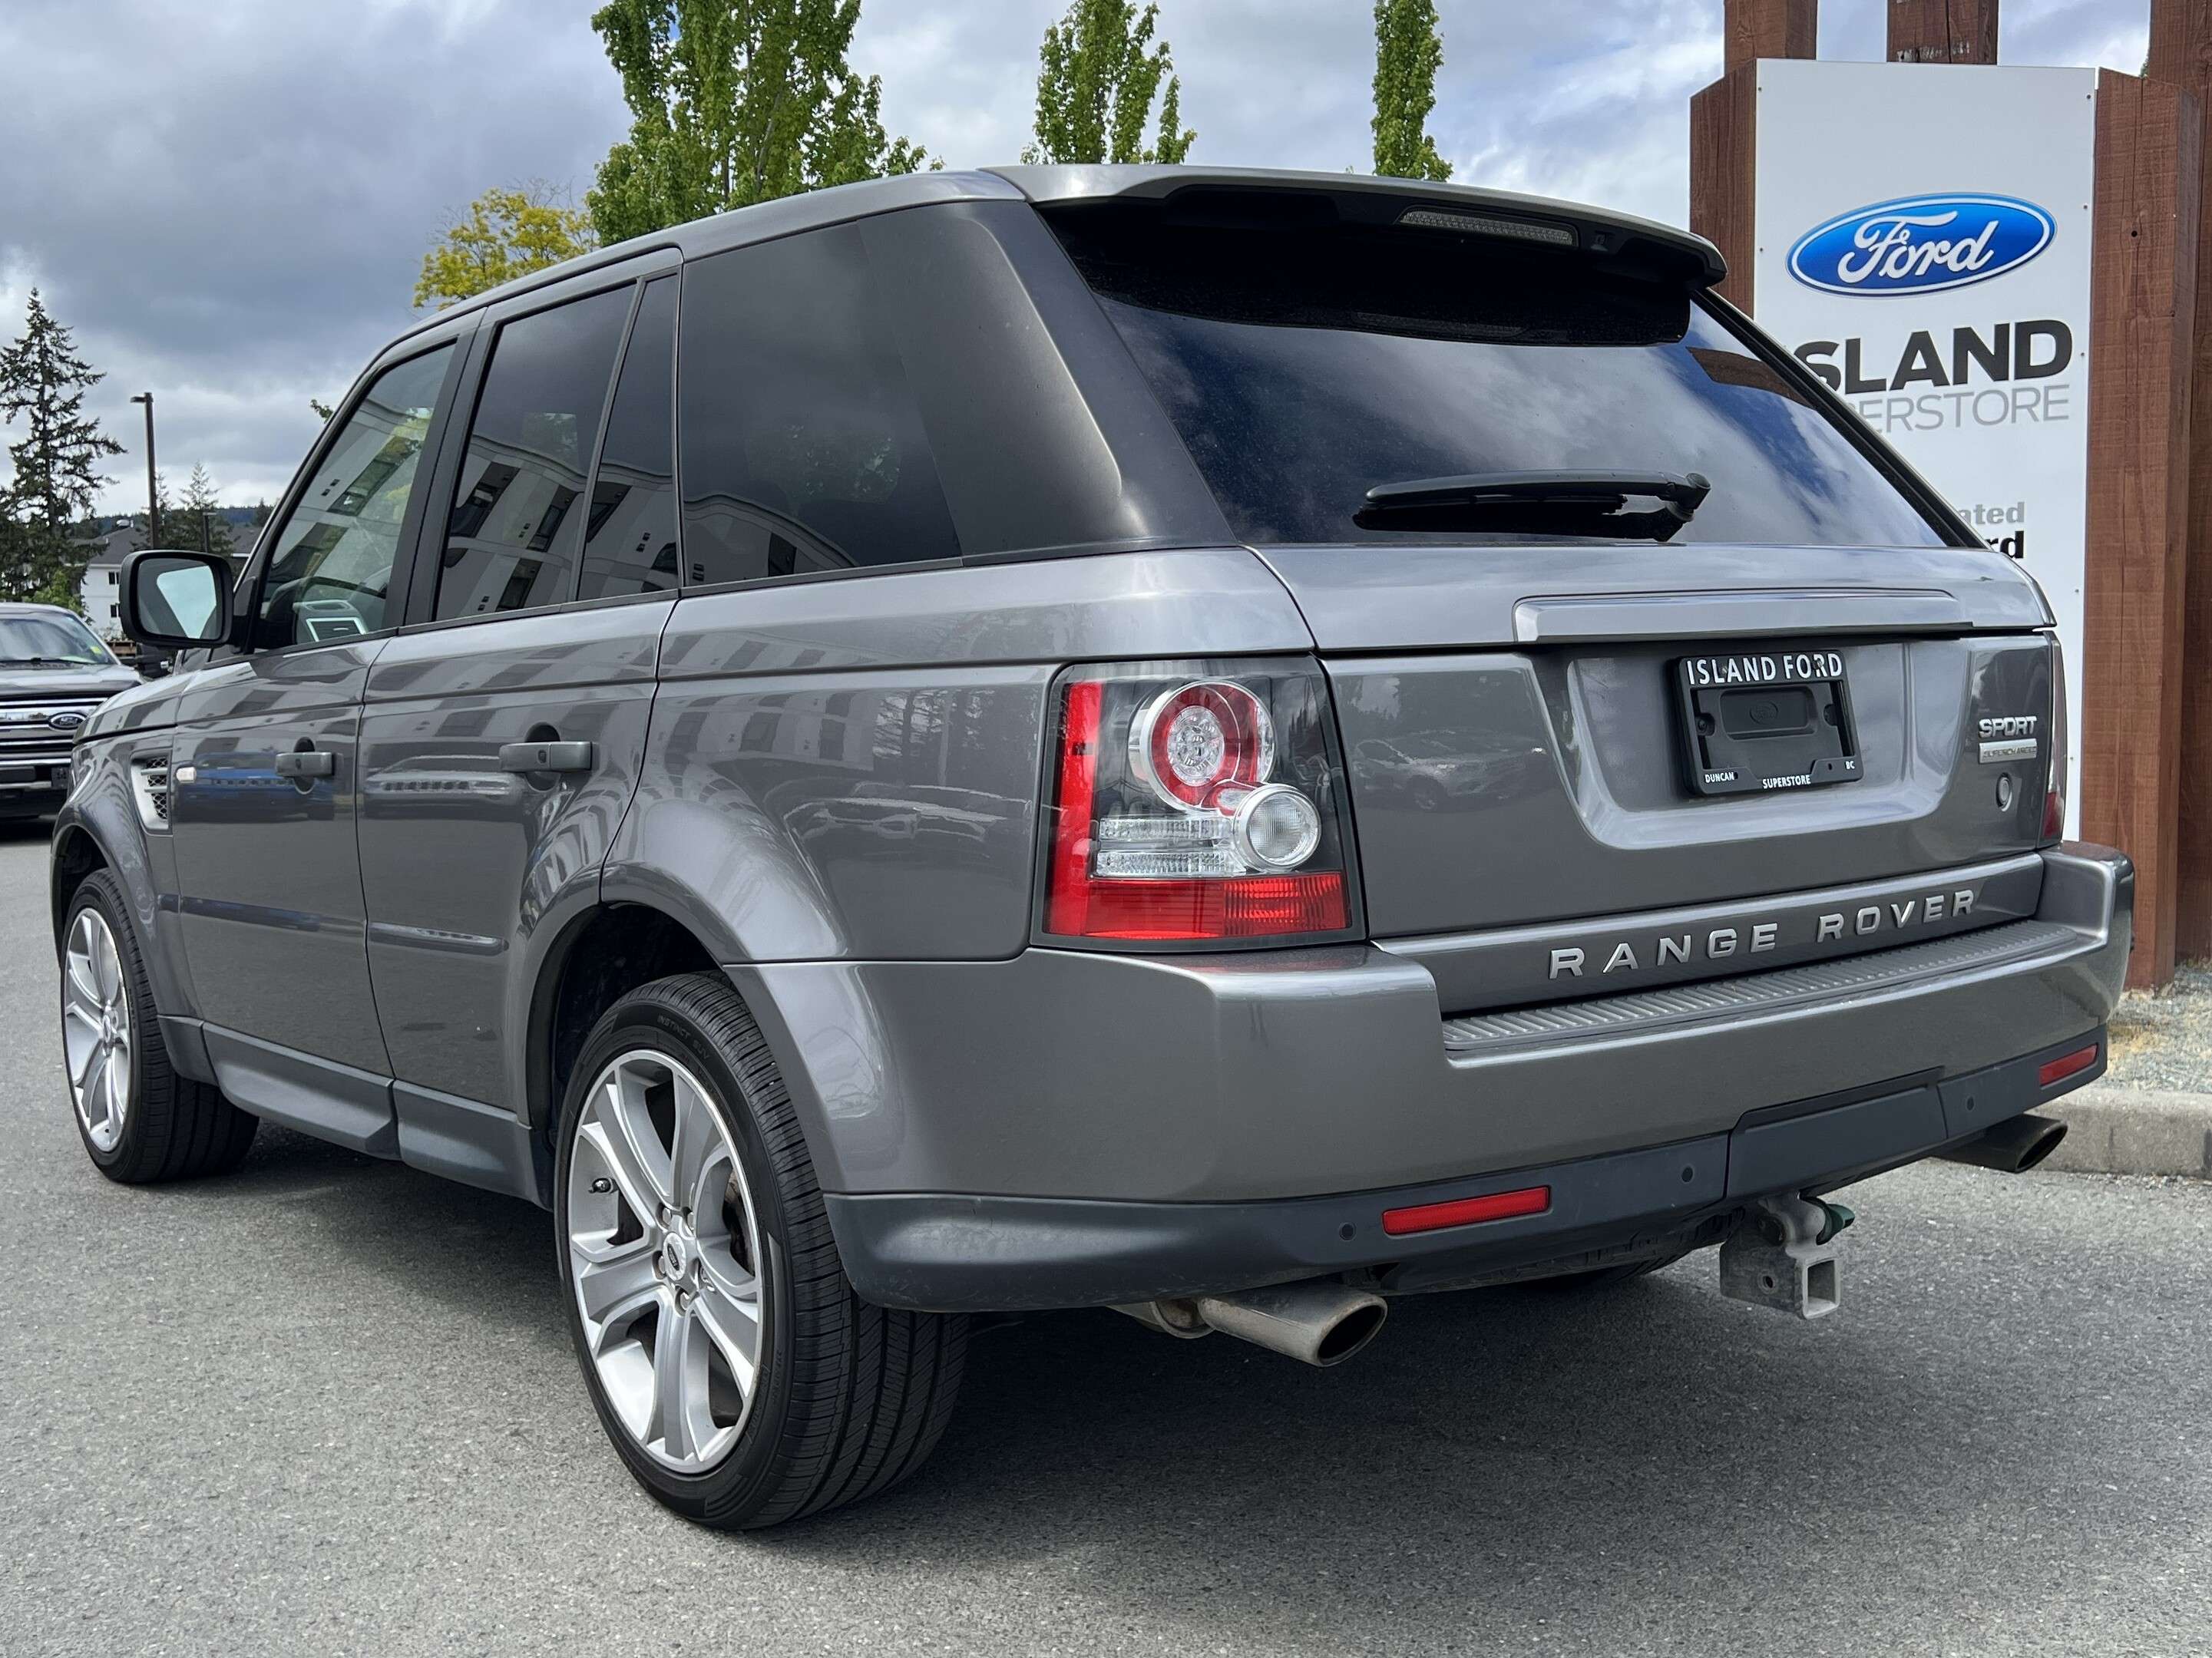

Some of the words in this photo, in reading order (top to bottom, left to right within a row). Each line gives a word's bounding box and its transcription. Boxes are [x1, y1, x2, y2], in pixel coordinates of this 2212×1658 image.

[1837, 210, 1999, 283] Ford
[1793, 319, 2073, 395] SLAND
[1849, 384, 2070, 434] ERSTORE
[1959, 501, 2025, 525] ated
[1687, 656, 1777, 685] ISLAND
[1783, 652, 1843, 679] FORD
[1979, 715, 2038, 738] SPORT
[1704, 771, 1735, 784] DUNCAN
[1762, 774, 1812, 789] SUPERSTORE
[1845, 761, 1856, 770] BC
[1549, 922, 1778, 979] RANGE
[1816, 889, 1975, 943] ROVER
